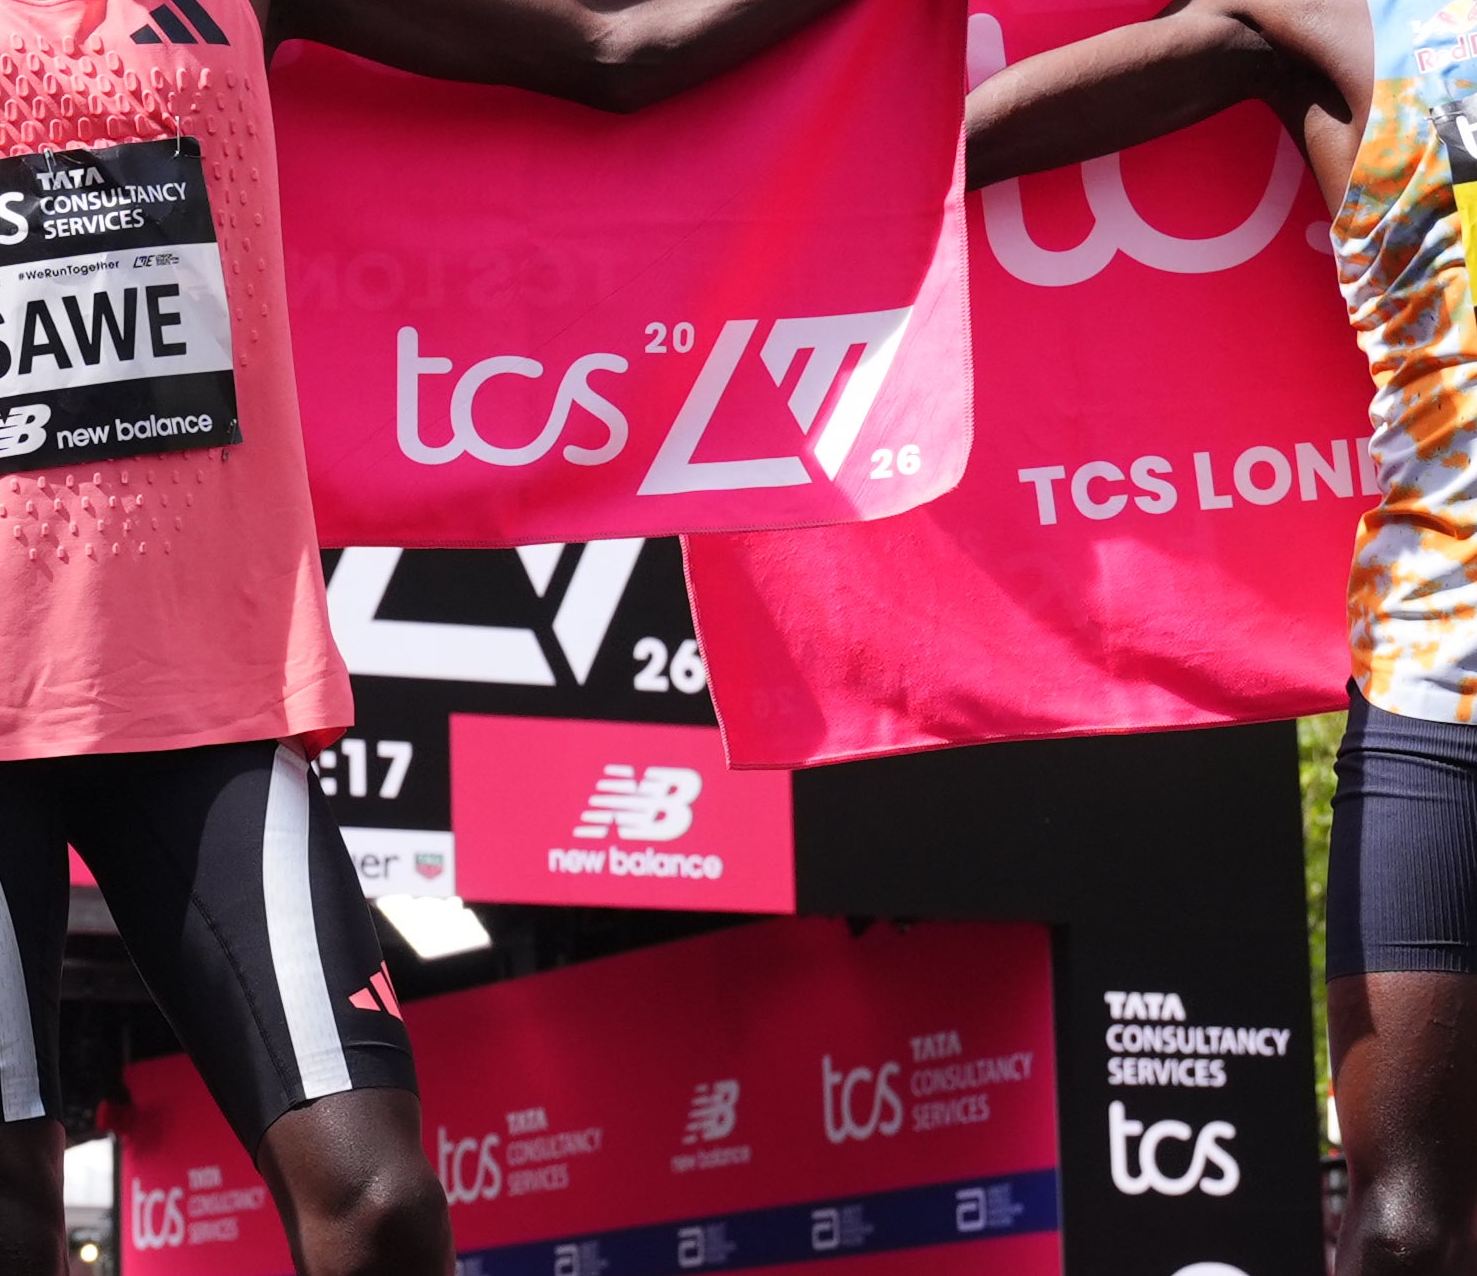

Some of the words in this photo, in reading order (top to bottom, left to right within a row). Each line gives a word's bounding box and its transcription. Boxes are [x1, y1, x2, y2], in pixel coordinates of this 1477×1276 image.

[1415, 35, 1467, 72] Rd
[36, 168, 106, 191] TATA
[39, 181, 188, 218] CONSULTANCY
[42, 207, 145, 241] SERVICES
[17, 258, 121, 282] #WeRunTogether
[397, 325, 629, 467] tcs
[644, 321, 696, 354] 20
[56, 419, 111, 451] new
[114, 412, 213, 443] balance
[870, 444, 922, 481] 26
[1018, 455, 1177, 526] TCS
[1195, 437, 1381, 511] LON
[633, 639, 706, 694] 26
[548, 846, 605, 875] new
[610, 848, 724, 881] balance
[1104, 990, 1187, 1022] TATA
[1105, 1023, 1291, 1057] CONSULTANCY
[822, 1052, 904, 1144] tcs
[909, 1029, 963, 1063] TATA
[910, 1050, 1035, 1099] CONSULTANCY
[1107, 1056, 1227, 1088] SERVICES
[910, 1093, 991, 1132] SERVICES
[437, 1126, 503, 1206] tcs
[506, 1105, 551, 1135] TATA
[506, 1128, 603, 1168] CONSULTANCY
[1109, 1100, 1241, 1197] tcs
[506, 1163, 570, 1198] SERVICES
[132, 1176, 186, 1251] tcs
